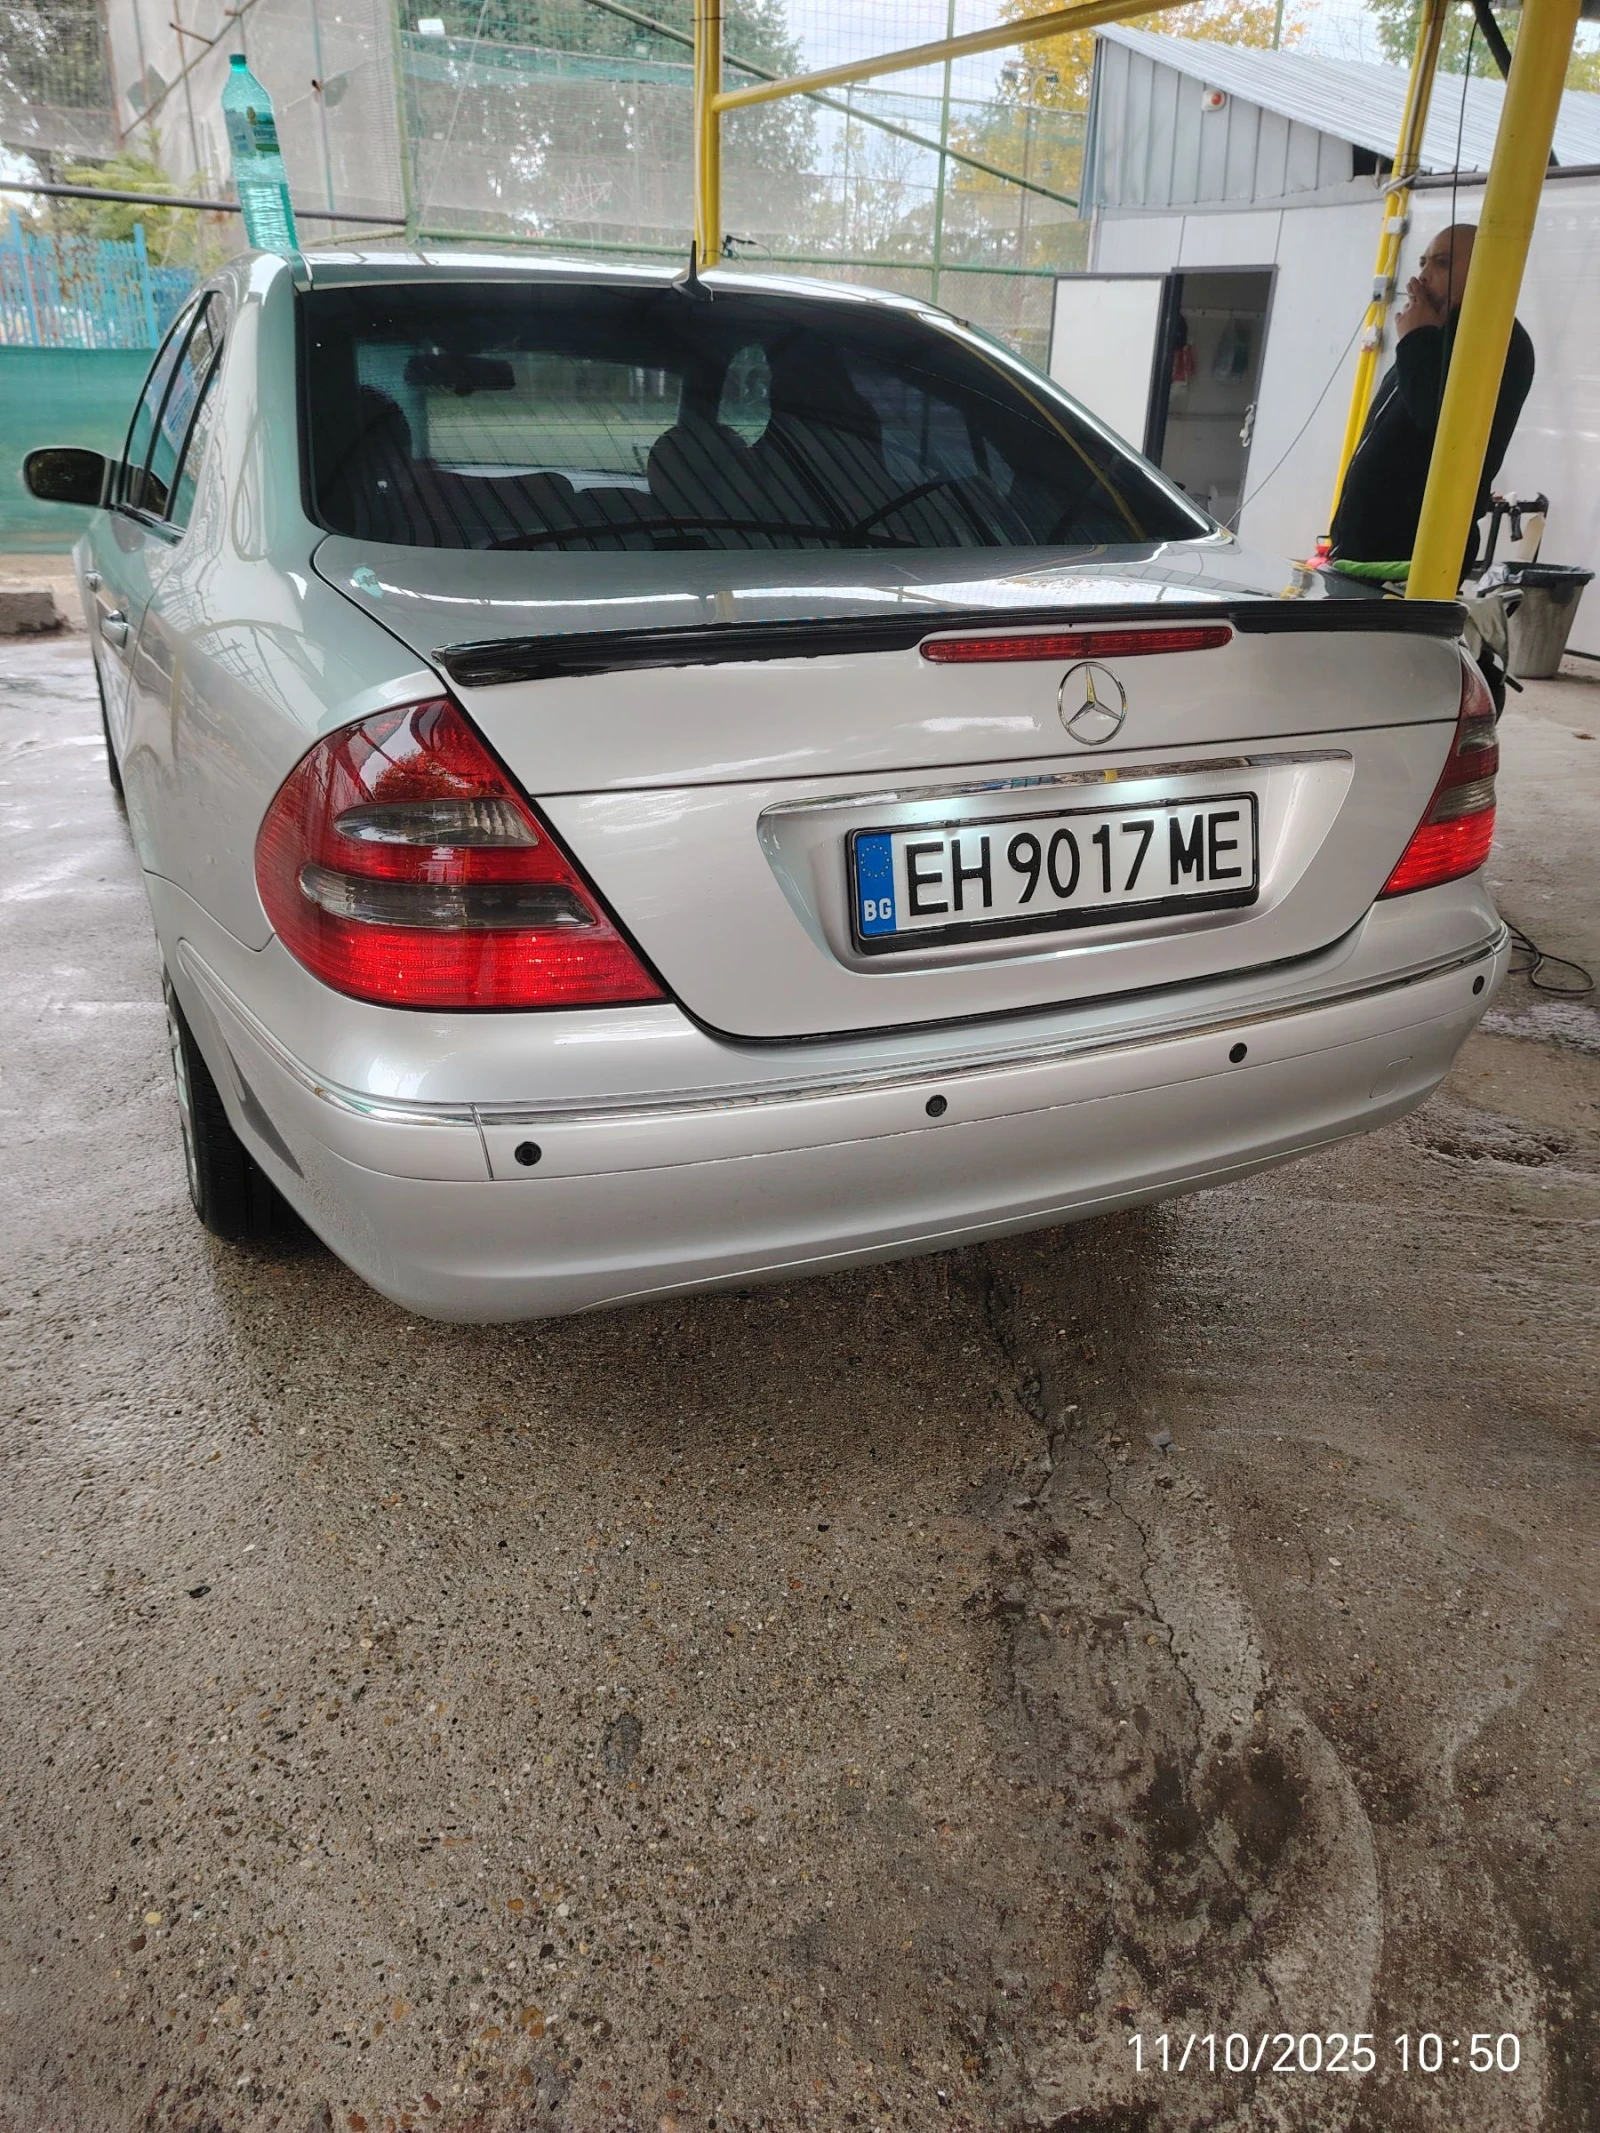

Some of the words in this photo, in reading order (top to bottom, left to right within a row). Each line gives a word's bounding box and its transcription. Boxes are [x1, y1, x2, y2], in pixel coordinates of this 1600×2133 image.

[905, 835, 993, 917] EH
[1006, 819, 1155, 904] 9017
[1169, 811, 1242, 886] ME
[863, 897, 893, 922] BG
